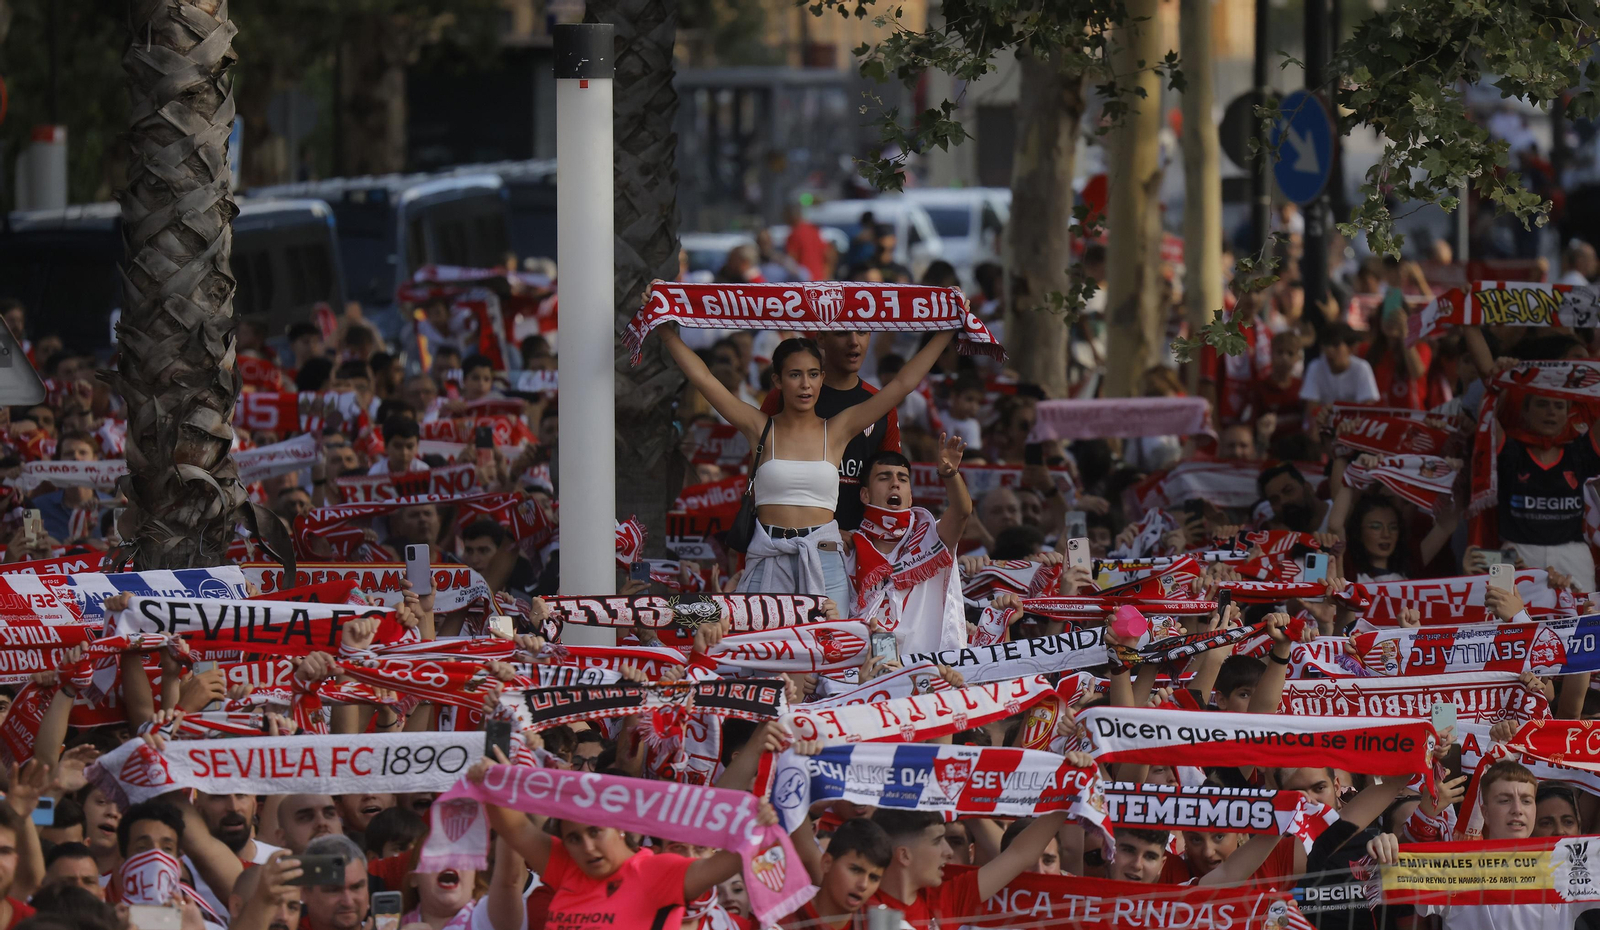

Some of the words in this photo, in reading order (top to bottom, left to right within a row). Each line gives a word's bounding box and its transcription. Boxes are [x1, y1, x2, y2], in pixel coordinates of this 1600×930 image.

[139, 600, 314, 646] SEVILLA
[0, 625, 62, 646] SEVILLA
[1567, 632, 1597, 654] 04
[983, 642, 1022, 663] TE
[1410, 645, 1436, 666] FC
[1441, 639, 1527, 664] SEVILLA
[697, 683, 778, 706] BIRIS
[1096, 716, 1172, 741] Dicen
[1177, 727, 1228, 747] que
[1234, 729, 1314, 749] nunca
[1321, 733, 1347, 751] se
[1353, 730, 1416, 753] rinde
[188, 746, 319, 779] SEVILLA
[331, 746, 374, 778] FC
[381, 743, 468, 778] 1890
[807, 757, 896, 786] SCHALKE
[900, 765, 930, 788] 04
[971, 771, 1057, 791] SEVILLA
[1062, 769, 1089, 791] FC
[1477, 857, 1510, 869] UEFA
[1514, 857, 1539, 869] CUP
[1396, 875, 1424, 884] ESTADIO
[1425, 875, 1447, 884] REYNO
[1448, 875, 1457, 884] DE
[1499, 875, 1519, 884] ABRIL
[1520, 874, 1536, 884] 2007
[1569, 877, 1592, 885] CUP
[1063, 893, 1103, 924] TE
[1112, 898, 1236, 930] RINDAS
